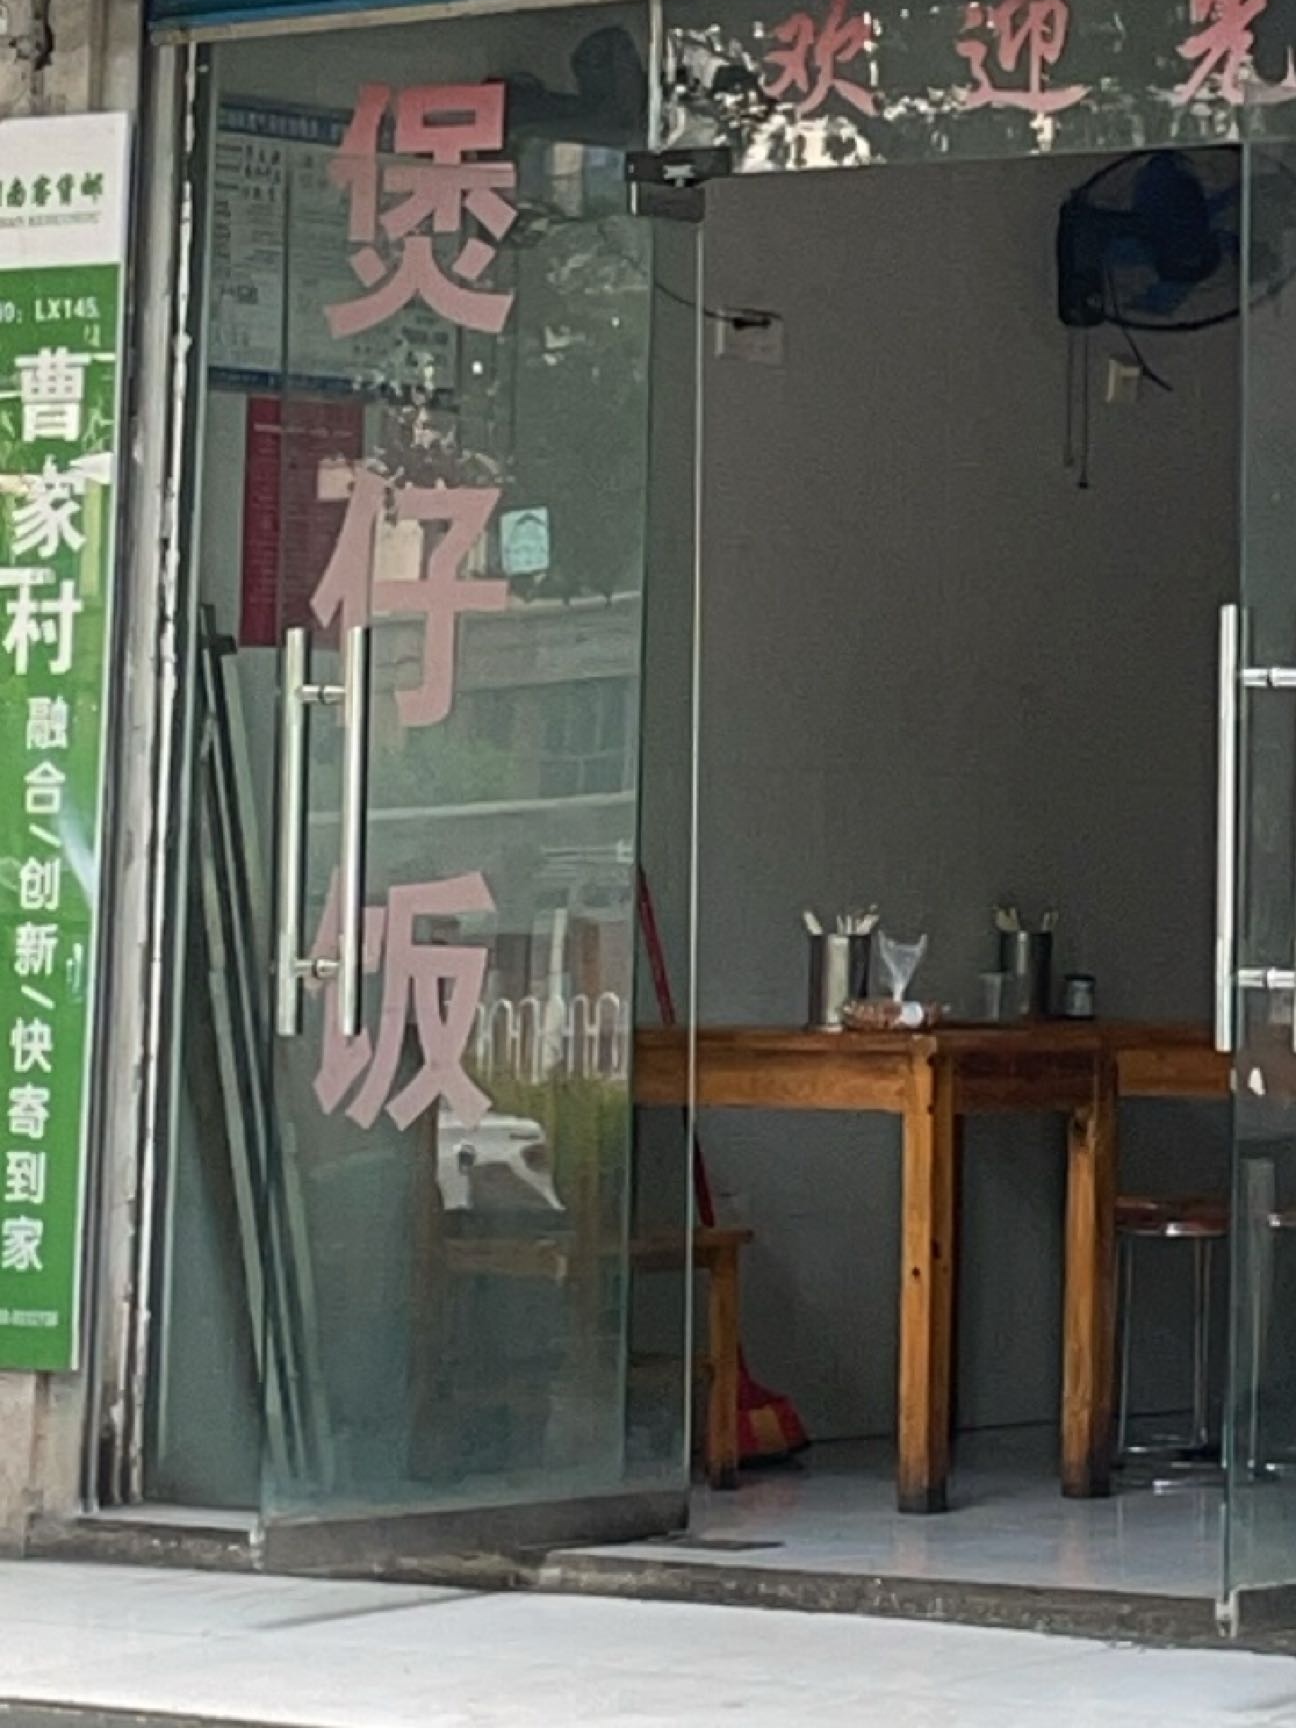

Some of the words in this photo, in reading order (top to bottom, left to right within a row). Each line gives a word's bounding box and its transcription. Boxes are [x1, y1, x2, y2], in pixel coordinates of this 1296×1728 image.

[3, 345, 92, 675] 曹家村
[309, 81, 519, 1132] 煲仔饭
